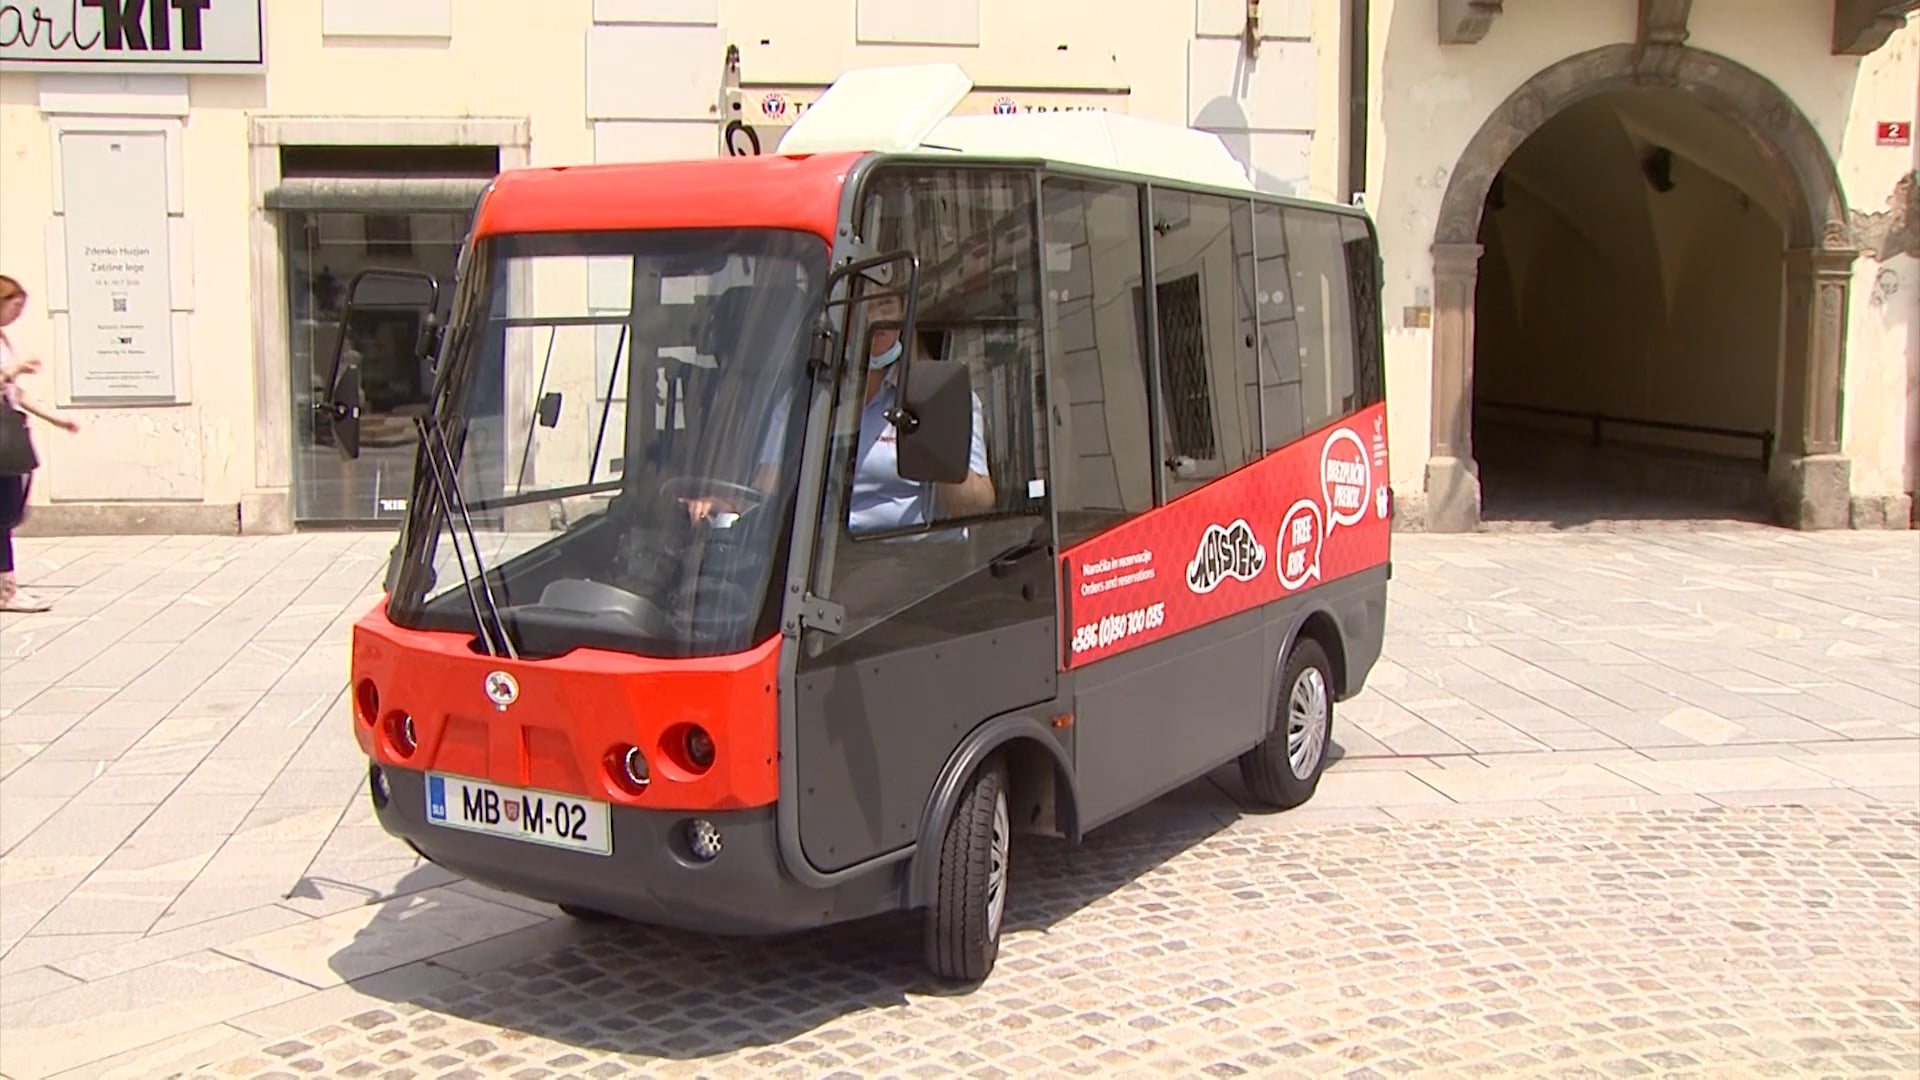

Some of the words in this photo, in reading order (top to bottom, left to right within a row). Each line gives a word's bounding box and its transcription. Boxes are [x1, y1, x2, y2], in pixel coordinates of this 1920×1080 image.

[1888, 124, 1900, 137] 2
[85, 245, 118, 256] Zdenko
[125, 262, 144, 273] lege
[1292, 515, 1312, 546] FREE
[1111, 556, 1119, 570] in
[1119, 549, 1153, 568] rezervacije
[1190, 525, 1263, 588] MAISTER
[1286, 548, 1306, 577] RIDE
[1081, 581, 1105, 597] Orders
[1104, 575, 1118, 591] and
[1118, 568, 1155, 587] reservations
[1072, 622, 1099, 653] +386
[1127, 608, 1145, 636] 100
[1146, 602, 1165, 630] 035
[462, 785, 500, 824] MB
[522, 795, 588, 841] M-02
